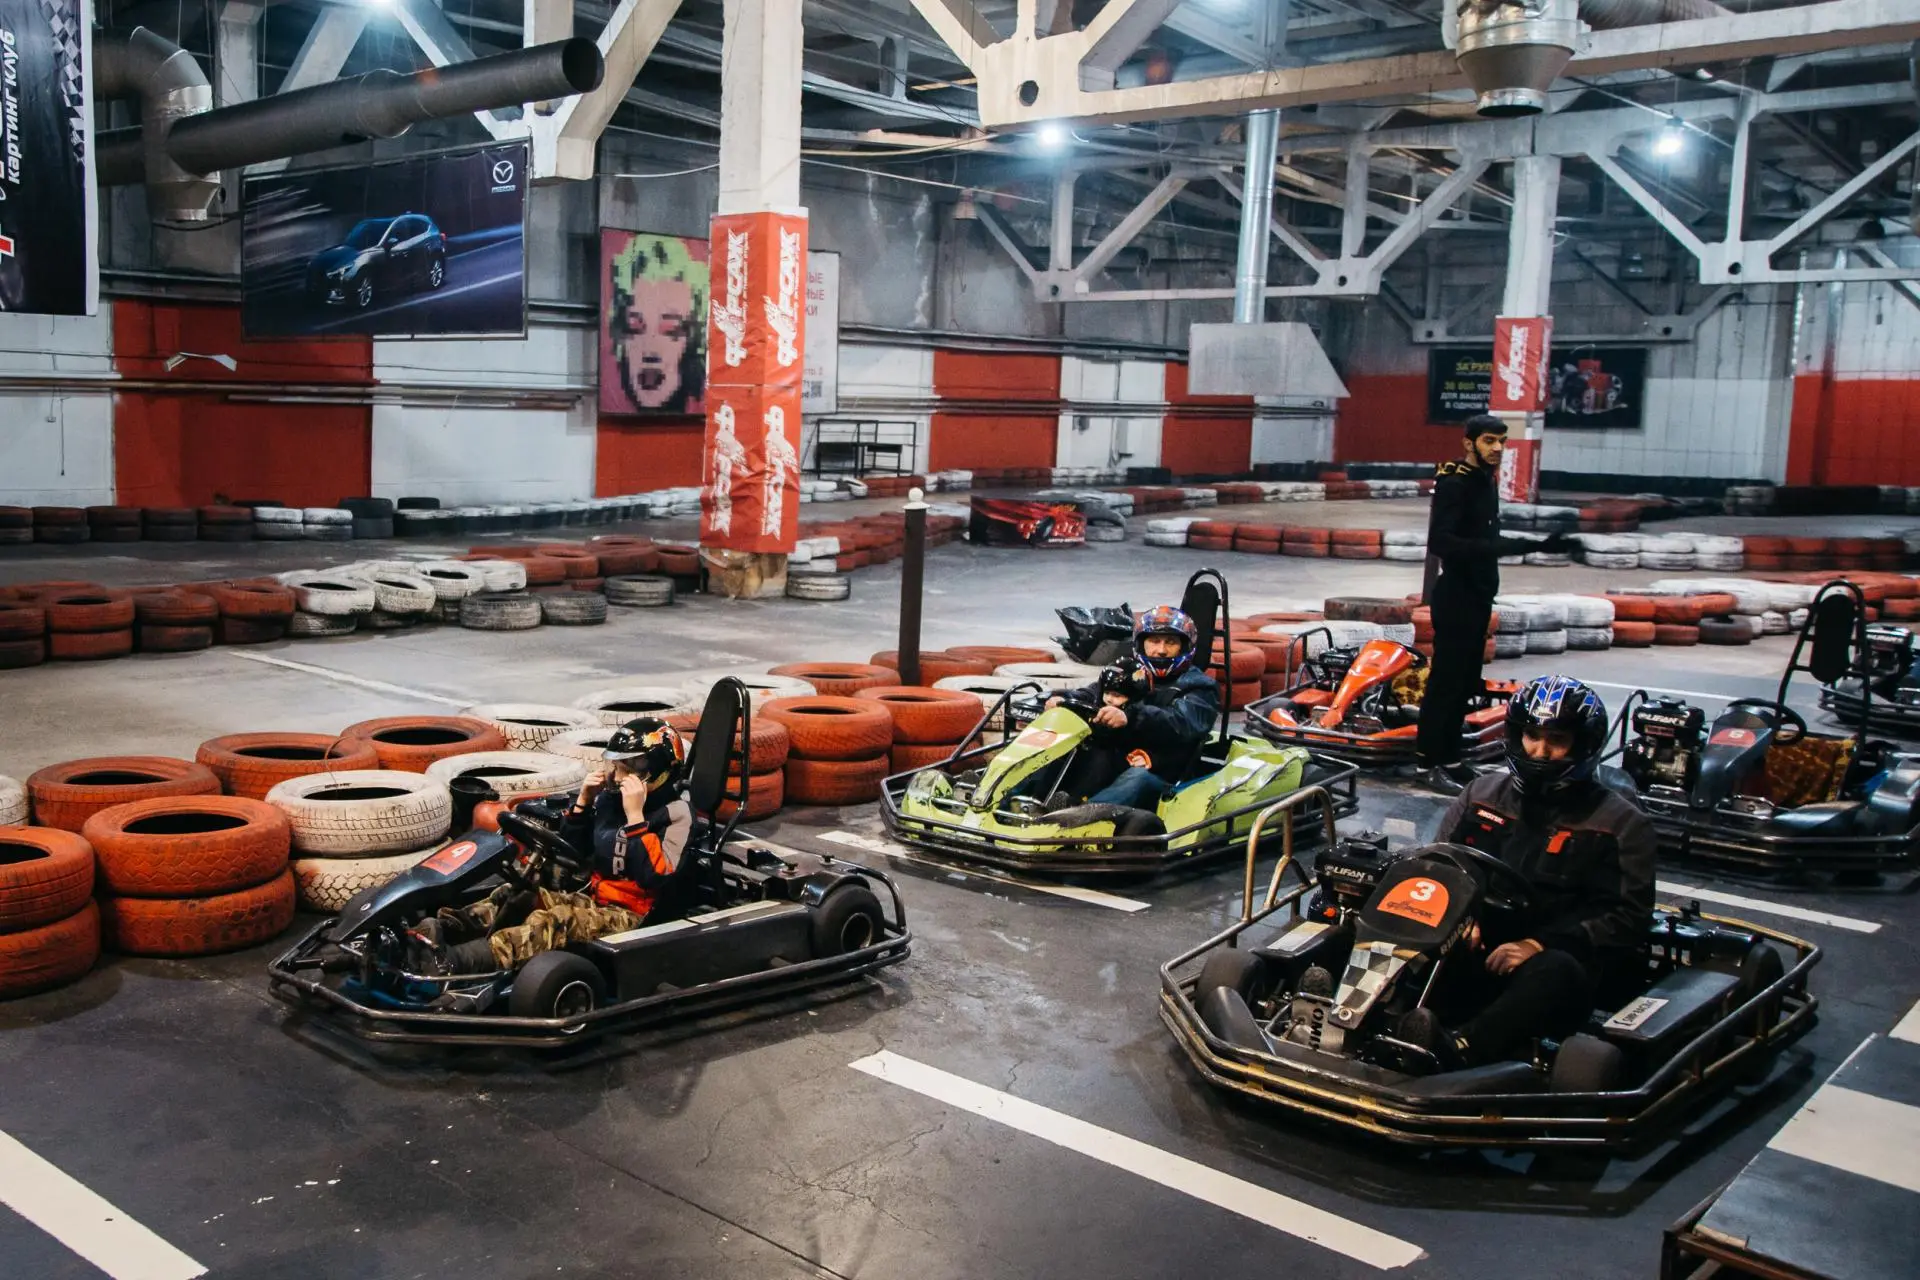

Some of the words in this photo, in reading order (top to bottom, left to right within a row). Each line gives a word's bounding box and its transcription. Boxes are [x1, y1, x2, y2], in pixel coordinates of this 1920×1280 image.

[0, 28, 18, 86] клуб
[4, 88, 22, 186] картинг
[451, 844, 473, 859] 4
[1333, 865, 1366, 881] LIFAN
[1409, 881, 1437, 901] 3
